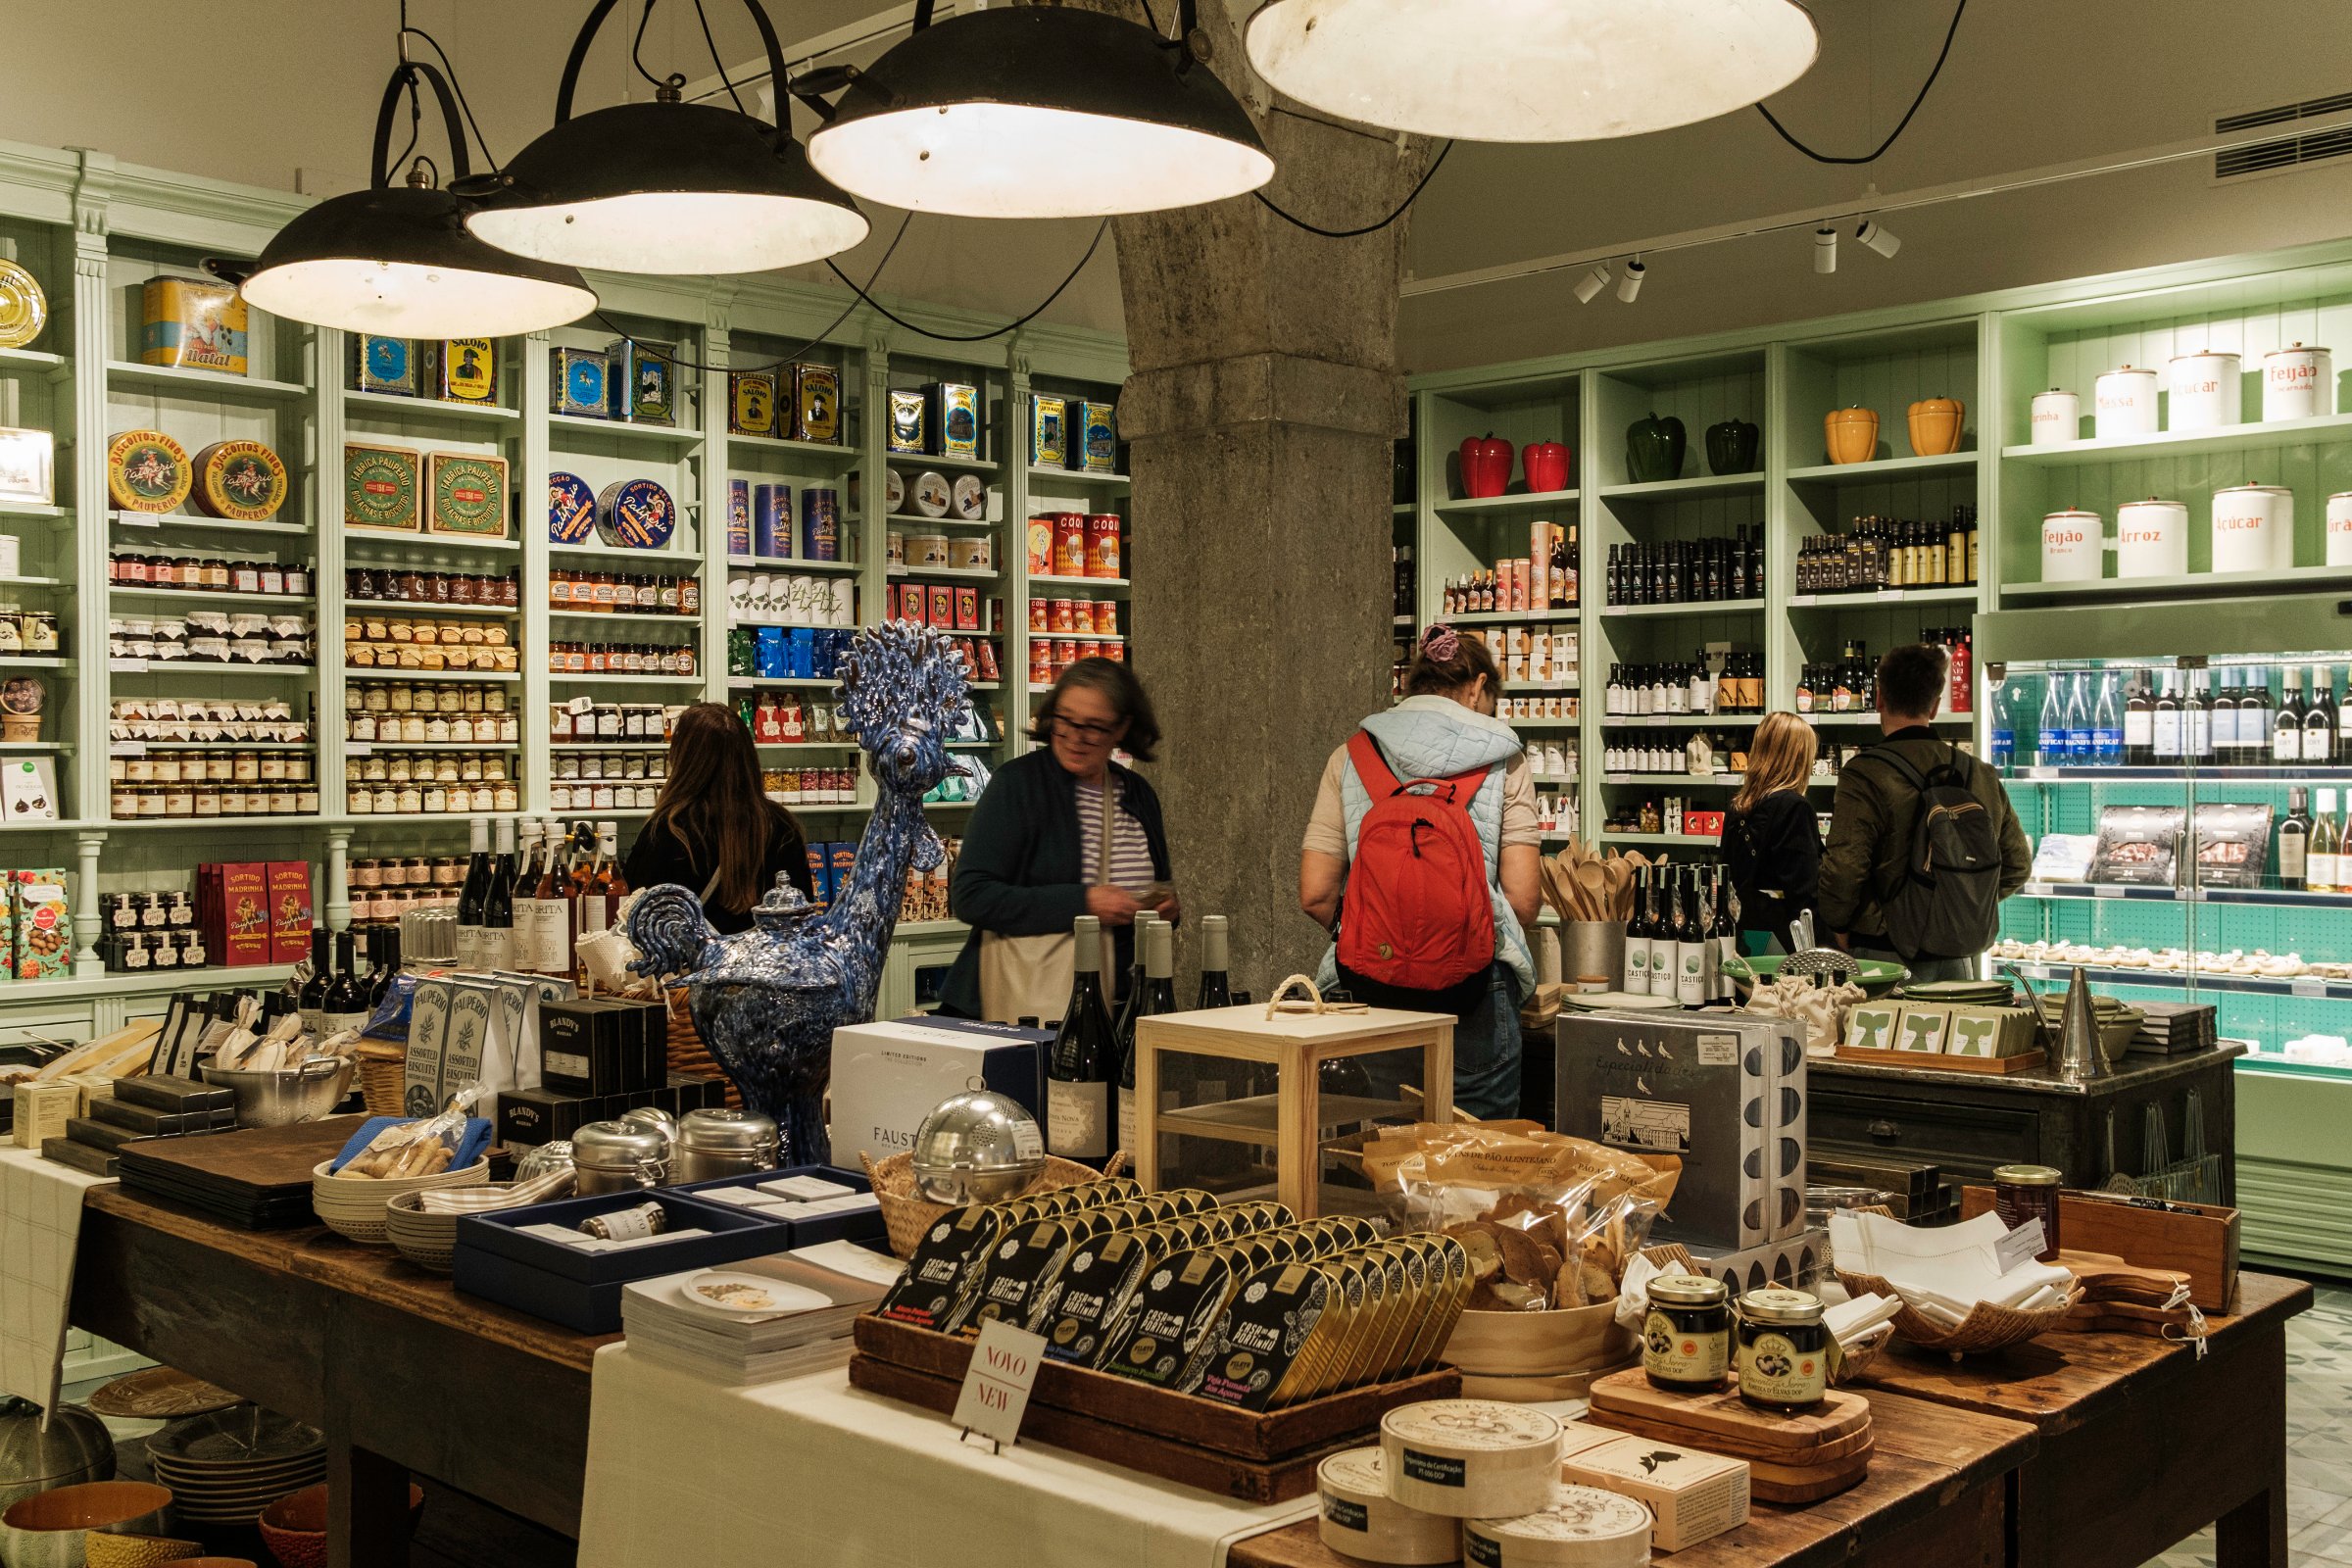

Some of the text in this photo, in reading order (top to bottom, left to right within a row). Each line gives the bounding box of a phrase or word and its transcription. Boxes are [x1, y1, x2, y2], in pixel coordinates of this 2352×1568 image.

[451, 339, 488, 351] SALOIO
[2271, 366, 2317, 382] Feijão
[110, 432, 186, 466] BISCOITOS FINOS
[212, 443, 284, 477] BISCOITOS FINOS
[630, 482, 658, 493] SORTIDO
[351, 490, 377, 518] BOLACHAS
[384, 494, 410, 518] BISCOITOS
[441, 497, 466, 525] BOLACHAS
[472, 501, 497, 525] BISCOITOS
[2216, 514, 2263, 532] Açúcar
[2328, 518, 2352, 533] Grã
[2044, 528, 2083, 544] Feijão
[2121, 527, 2162, 544] Arroz
[230, 873, 261, 883] SORTIDO
[274, 871, 303, 881] SORTIDO
[227, 885, 264, 894] MADRINHA
[549, 1016, 579, 1033] BLANDY'S
[410, 1046, 438, 1060] ASSORTED
[903, 1054, 927, 1062] EDITIONS
[447, 1054, 477, 1068] ASSORTED
[408, 1061, 436, 1076] BISCUITS
[446, 1068, 475, 1081] BISCUITS
[509, 1106, 540, 1124] BLANDY'S
[873, 1127, 917, 1148] FAUST
[1485, 1152, 1500, 1161] PÃO
[1501, 1155, 1557, 1164] ALENTEJANO
[926, 1257, 946, 1269] CASA
[995, 1276, 1013, 1288] CASA
[1067, 1290, 1089, 1302] CASA
[1146, 1309, 1167, 1321] CASA
[1238, 1321, 1262, 1334] CASA
[983, 1345, 1027, 1377] NOVO
[1204, 1384, 1218, 1394] dos
[974, 1382, 1013, 1412] NEW
